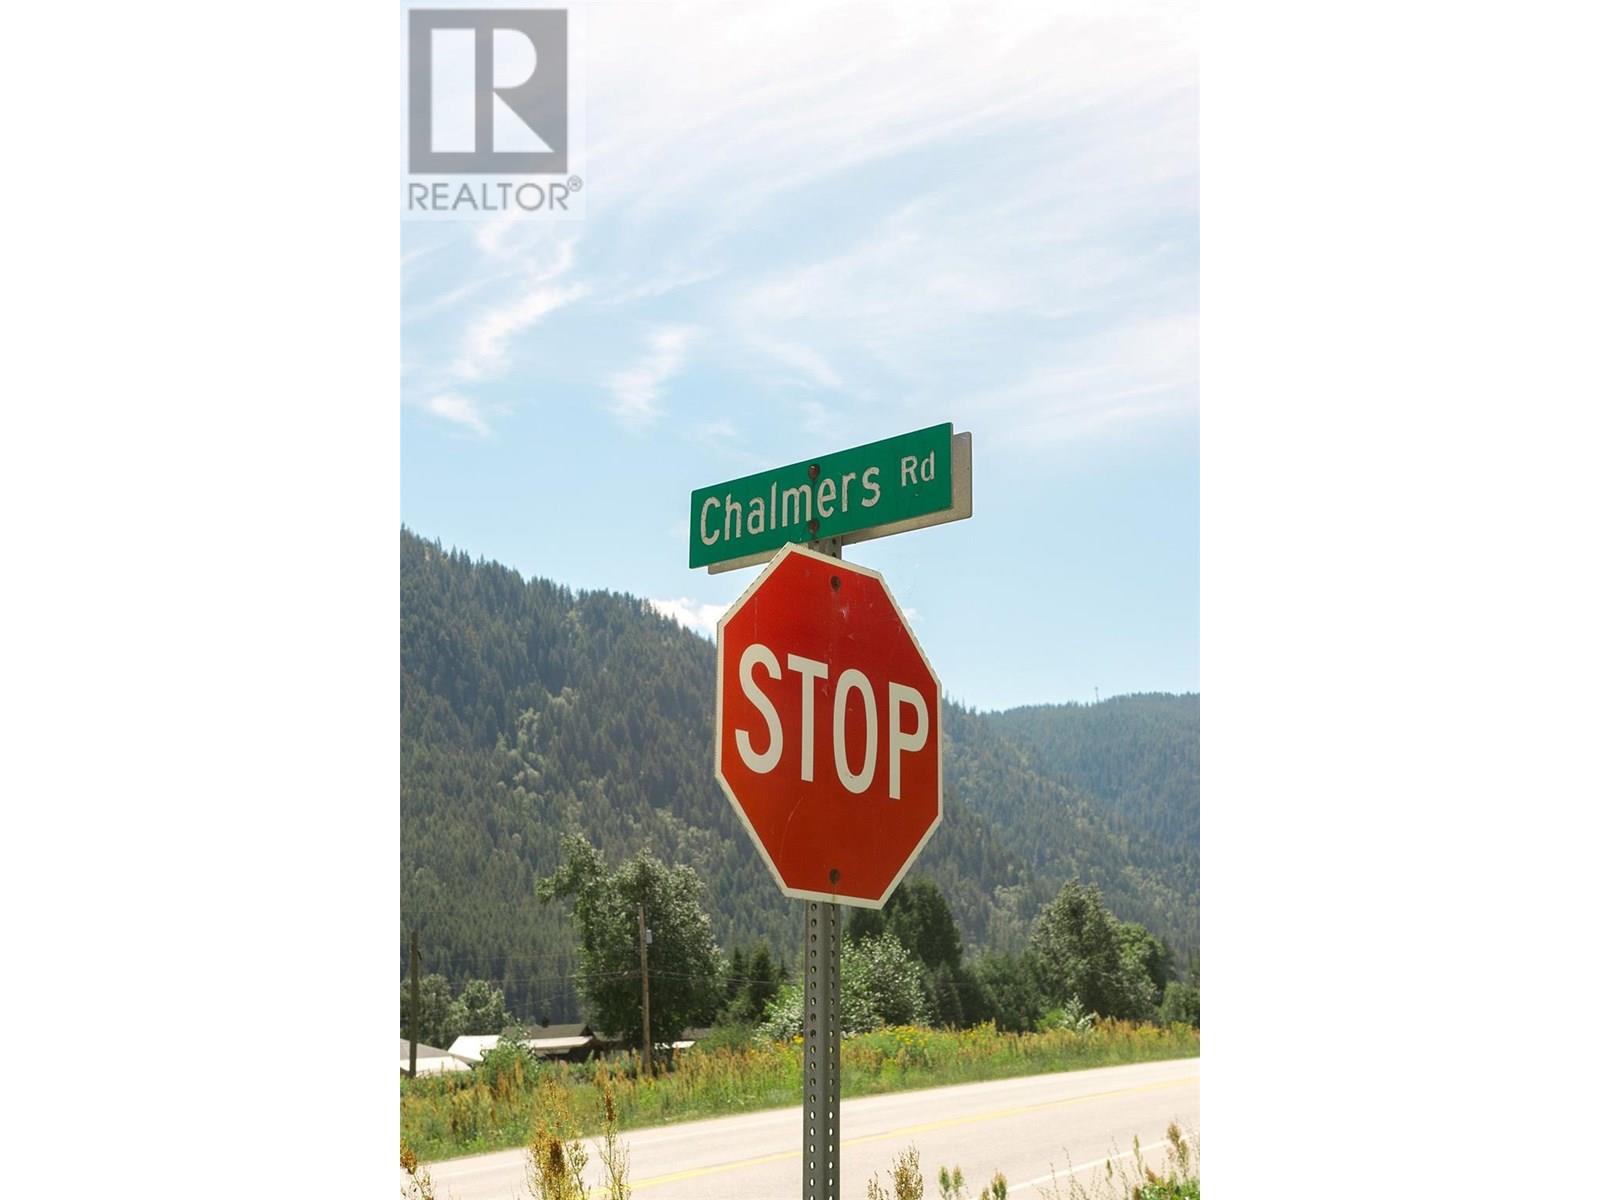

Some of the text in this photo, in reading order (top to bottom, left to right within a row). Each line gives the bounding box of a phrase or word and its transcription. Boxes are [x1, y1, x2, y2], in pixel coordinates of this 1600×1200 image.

[699, 450, 936, 546] Chalmers Rd
[734, 642, 930, 801] STOP
